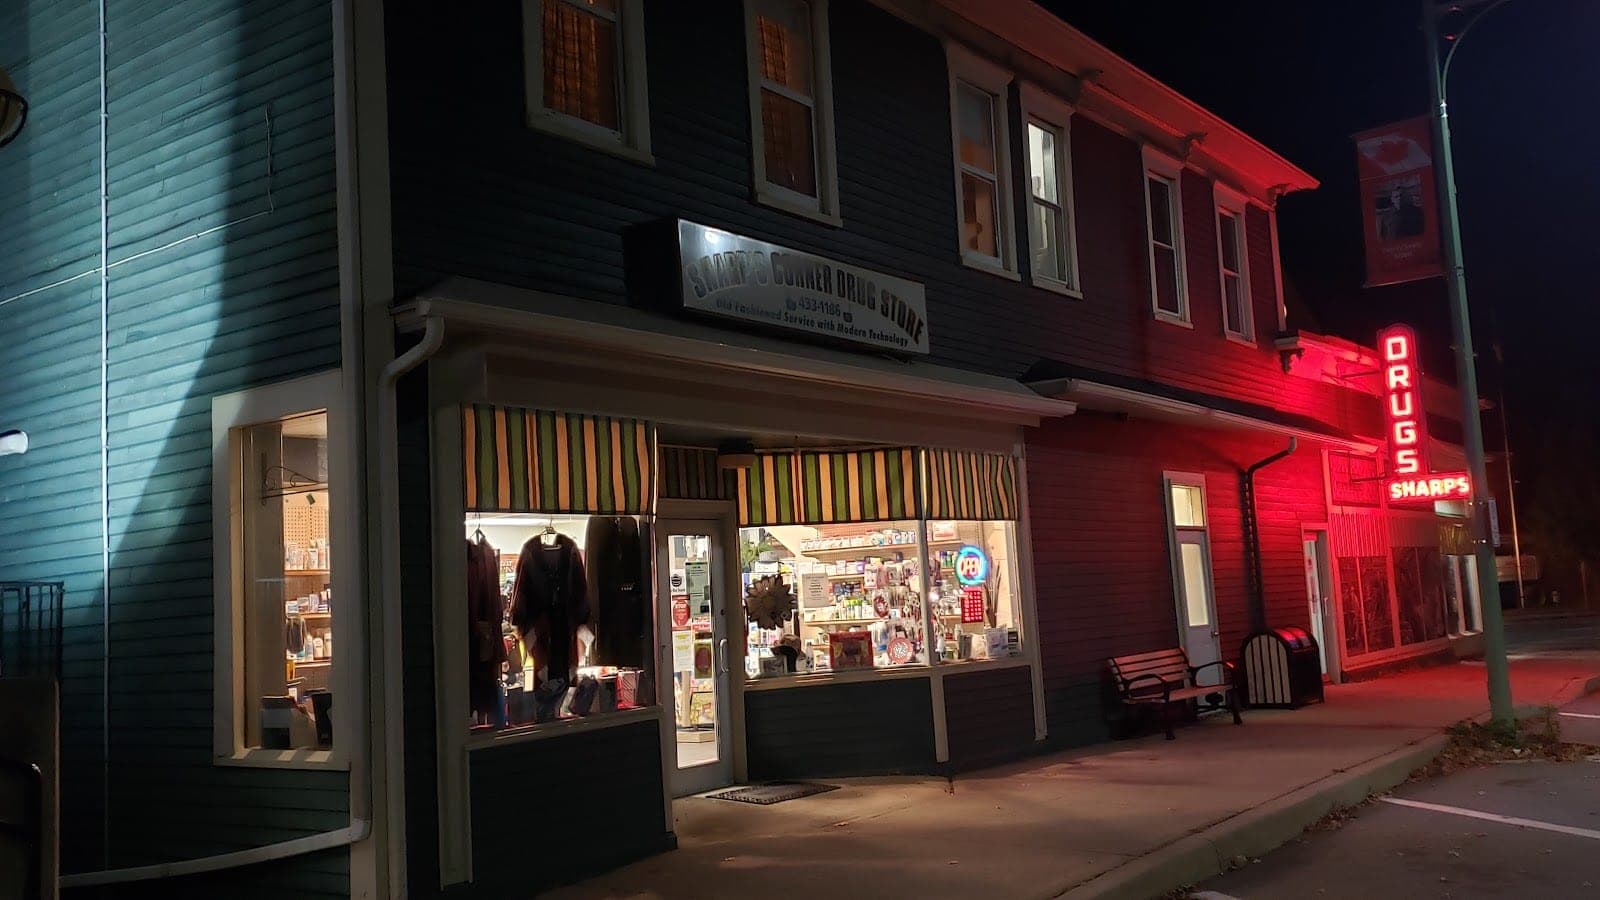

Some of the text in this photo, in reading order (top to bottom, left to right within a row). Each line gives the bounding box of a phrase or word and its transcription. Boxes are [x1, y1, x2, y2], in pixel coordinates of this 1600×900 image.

[837, 269, 876, 310] DRUG
[880, 289, 924, 345] STORE
[784, 311, 815, 328] Service
[817, 319, 835, 331] with
[837, 323, 867, 338] Modern
[869, 329, 909, 348] Technology
[1386, 336, 1419, 474] DRUGS
[1390, 476, 1470, 499] SHARPS
[960, 556, 981, 576] OPEN
